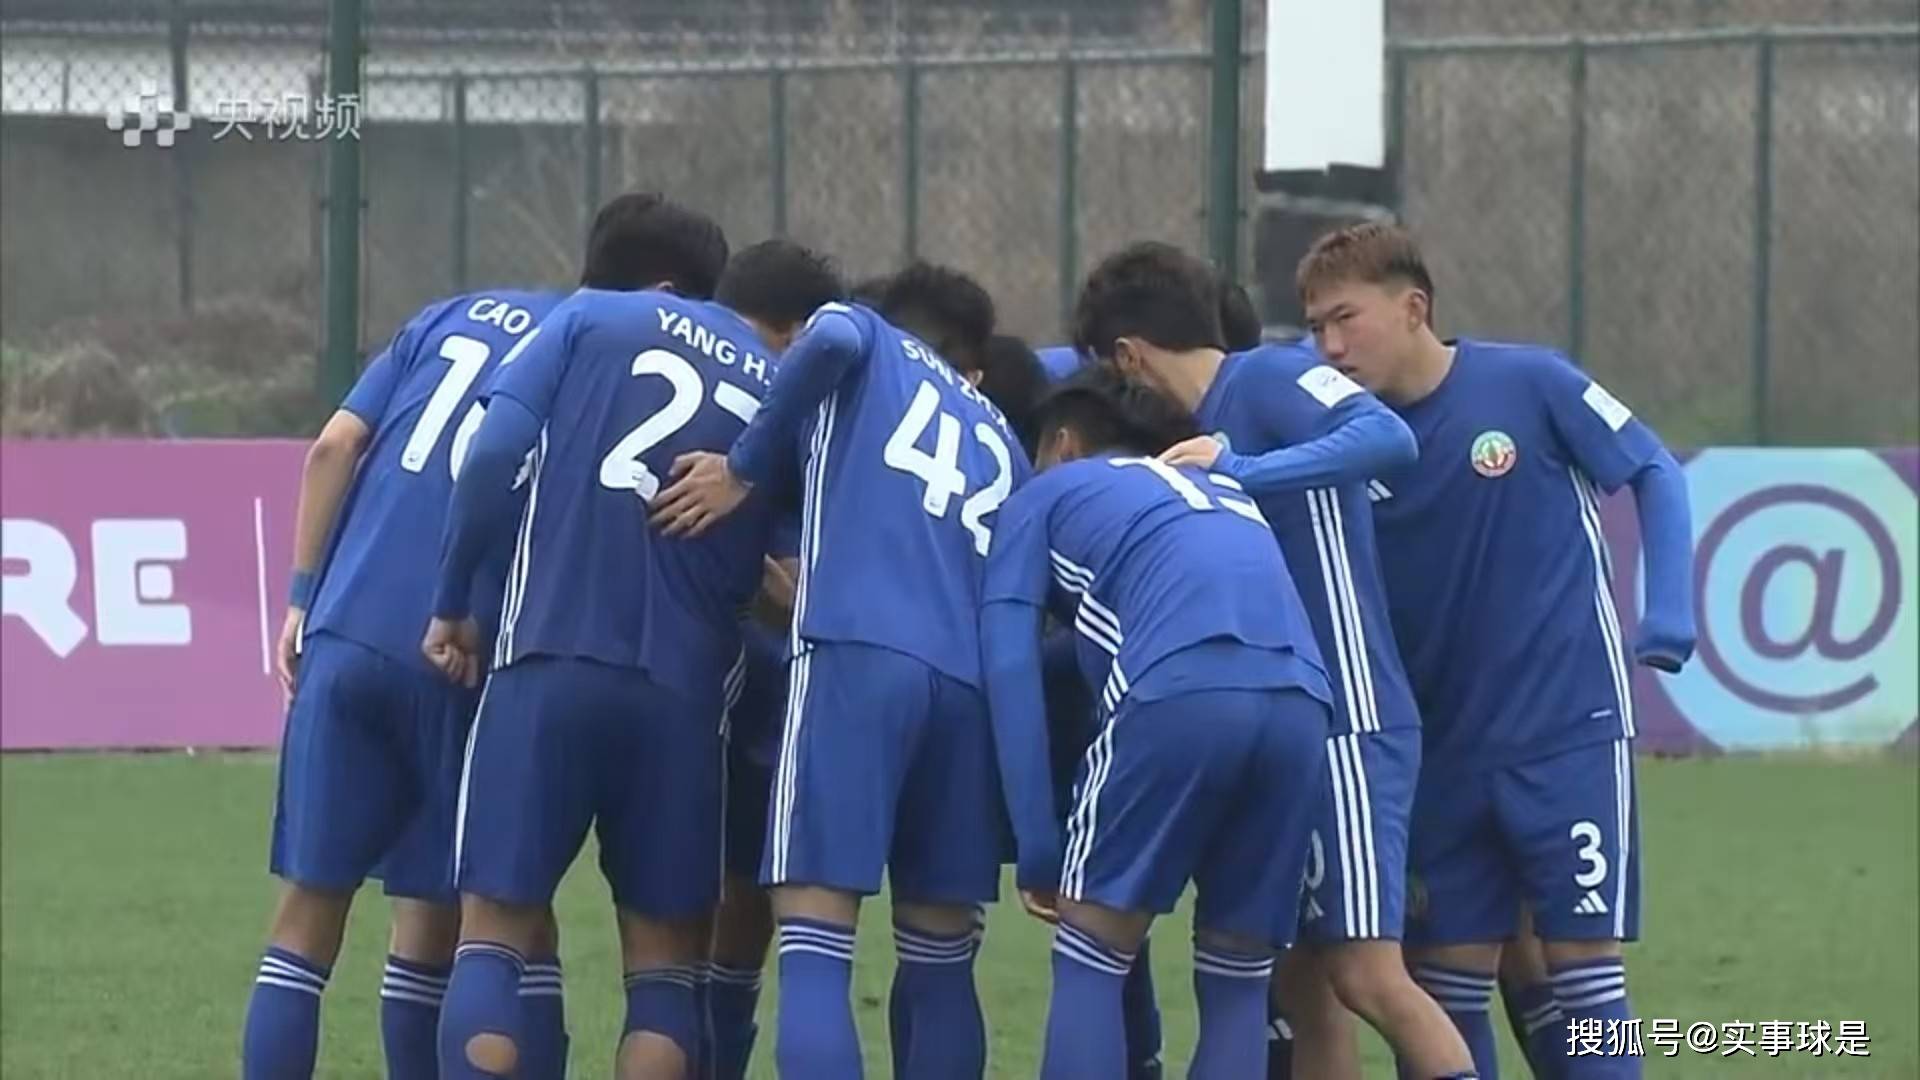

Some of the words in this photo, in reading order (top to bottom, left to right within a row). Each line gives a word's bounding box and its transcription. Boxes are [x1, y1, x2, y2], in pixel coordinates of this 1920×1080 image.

[467, 299, 531, 334] CAO
[656, 308, 737, 365] YANG
[901, 339, 954, 386] SUN
[884, 380, 1012, 557] 42
[1570, 821, 1608, 887] 3
